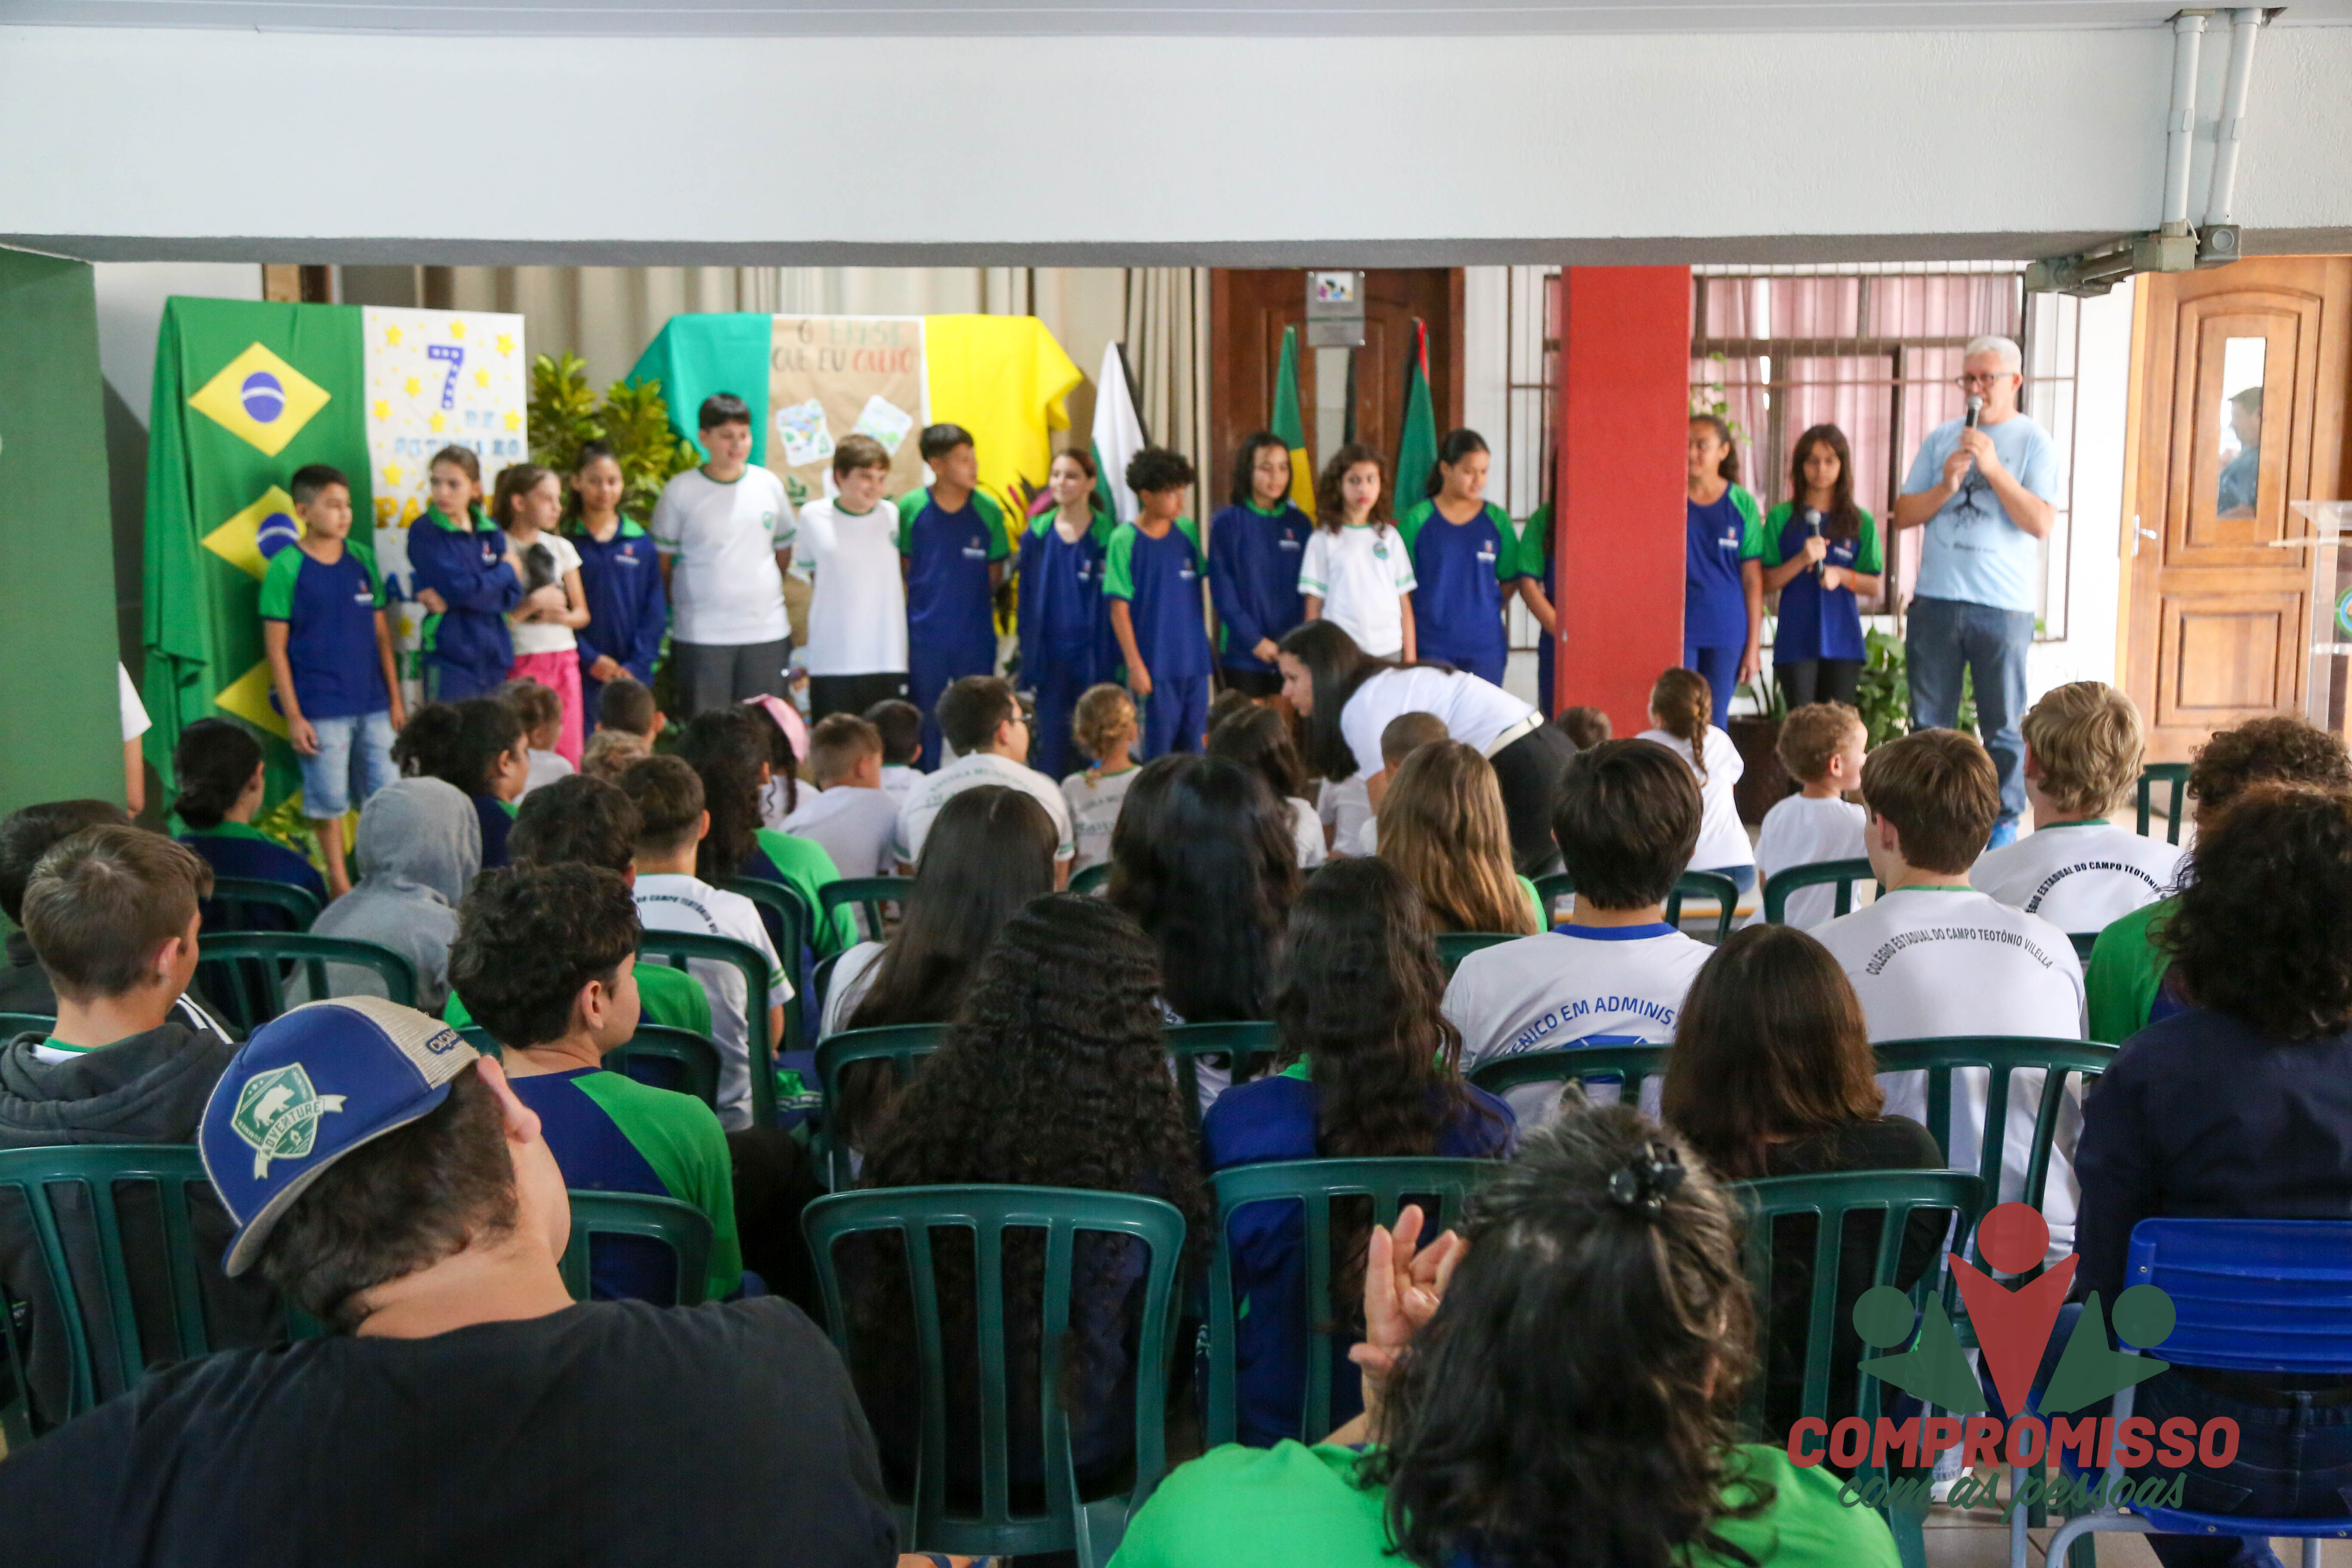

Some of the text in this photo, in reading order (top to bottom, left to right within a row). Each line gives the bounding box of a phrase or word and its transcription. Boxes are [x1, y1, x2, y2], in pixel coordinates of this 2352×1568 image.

[428, 345, 464, 409] 7
[2074, 863, 2087, 872] DO
[2089, 861, 2122, 870] CAMPO
[1866, 928, 2053, 975] COLÉGIO ESTADUAL DO CAMPO TEOTÔNIO VILELLA
[1561, 999, 1590, 1022] EM
[1594, 996, 1675, 1026] ADMINIS
[262, 1100, 322, 1155] ADVENTURE
